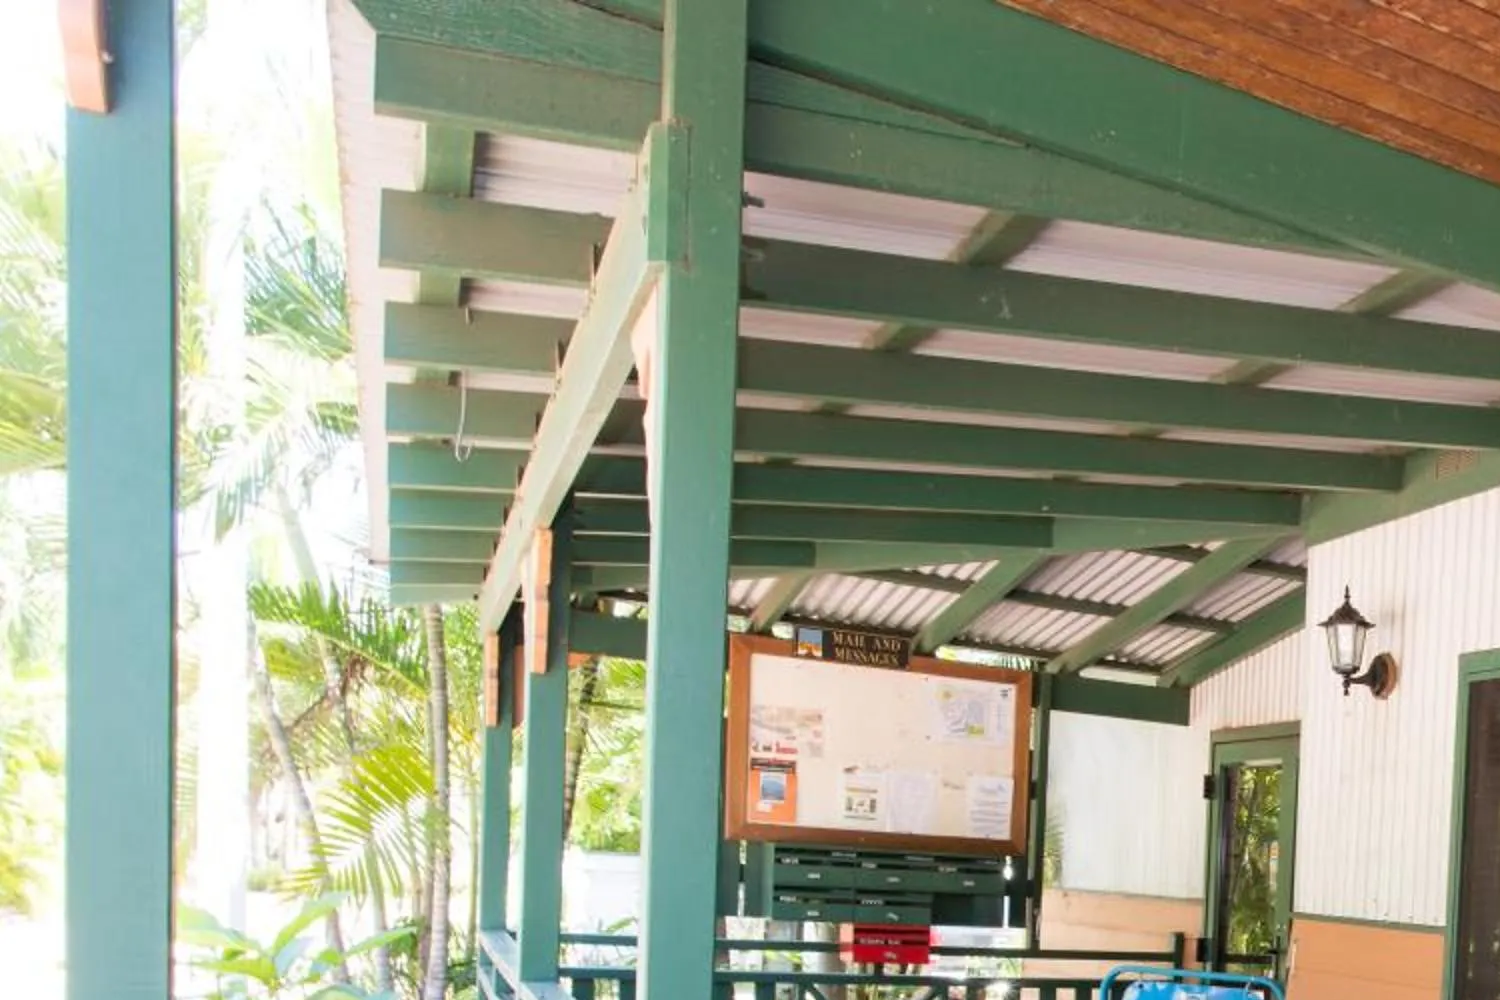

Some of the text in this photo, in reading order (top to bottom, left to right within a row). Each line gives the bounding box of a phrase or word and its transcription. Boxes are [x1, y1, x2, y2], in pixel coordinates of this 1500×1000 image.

[833, 631, 901, 651] MAIL AND
[835, 647, 899, 665] MESSAGES
